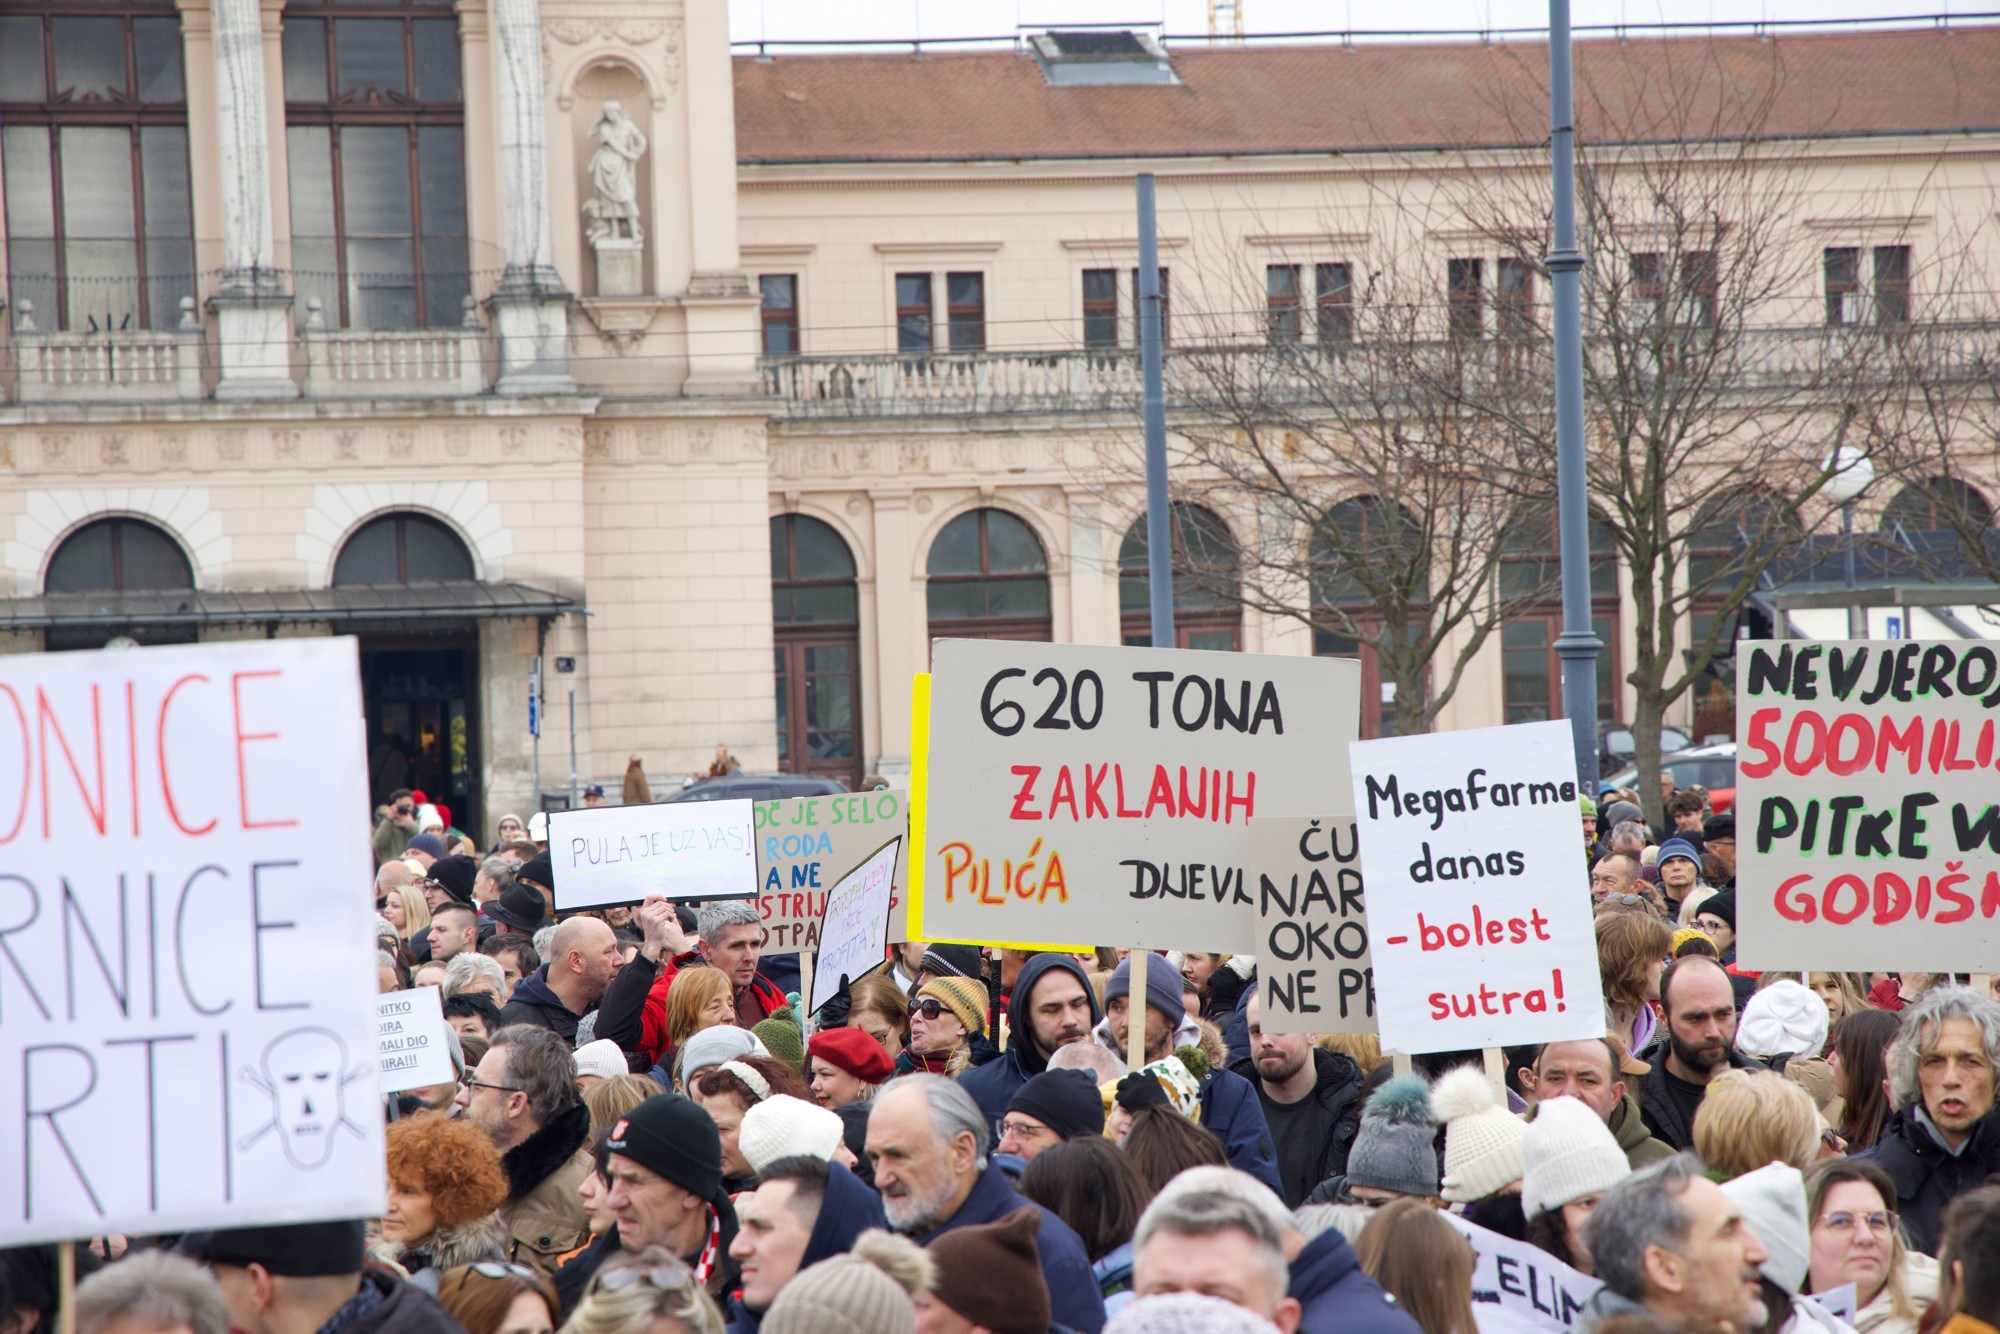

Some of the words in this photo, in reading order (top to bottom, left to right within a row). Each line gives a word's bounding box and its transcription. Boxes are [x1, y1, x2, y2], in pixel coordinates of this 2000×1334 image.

[980, 667, 1104, 736] 620
[1132, 670, 1284, 735] TONA
[791, 800, 819, 827] JE
[831, 794, 898, 826] SELO
[1009, 762, 1256, 826] ZAKLANIH
[571, 835, 633, 868] PULA
[639, 832, 663, 858] JE
[669, 828, 697, 852] UZ
[702, 823, 752, 857] VAS!
[765, 831, 834, 863] RODA
[1299, 819, 1360, 863] ČU
[1757, 791, 1939, 860] PITKE
[765, 866, 782, 891] A
[791, 862, 822, 889] NE
[937, 836, 1070, 906] PILIĆA
[1409, 842, 1525, 884] danas
[1260, 868, 1365, 918] NAR
[1268, 921, 1368, 962] OKO
[1268, 970, 1321, 1014] NE
[1427, 968, 1567, 1021] sutra!
[406, 1034, 429, 1047] DIO
[22, 1030, 234, 1222] RTI
